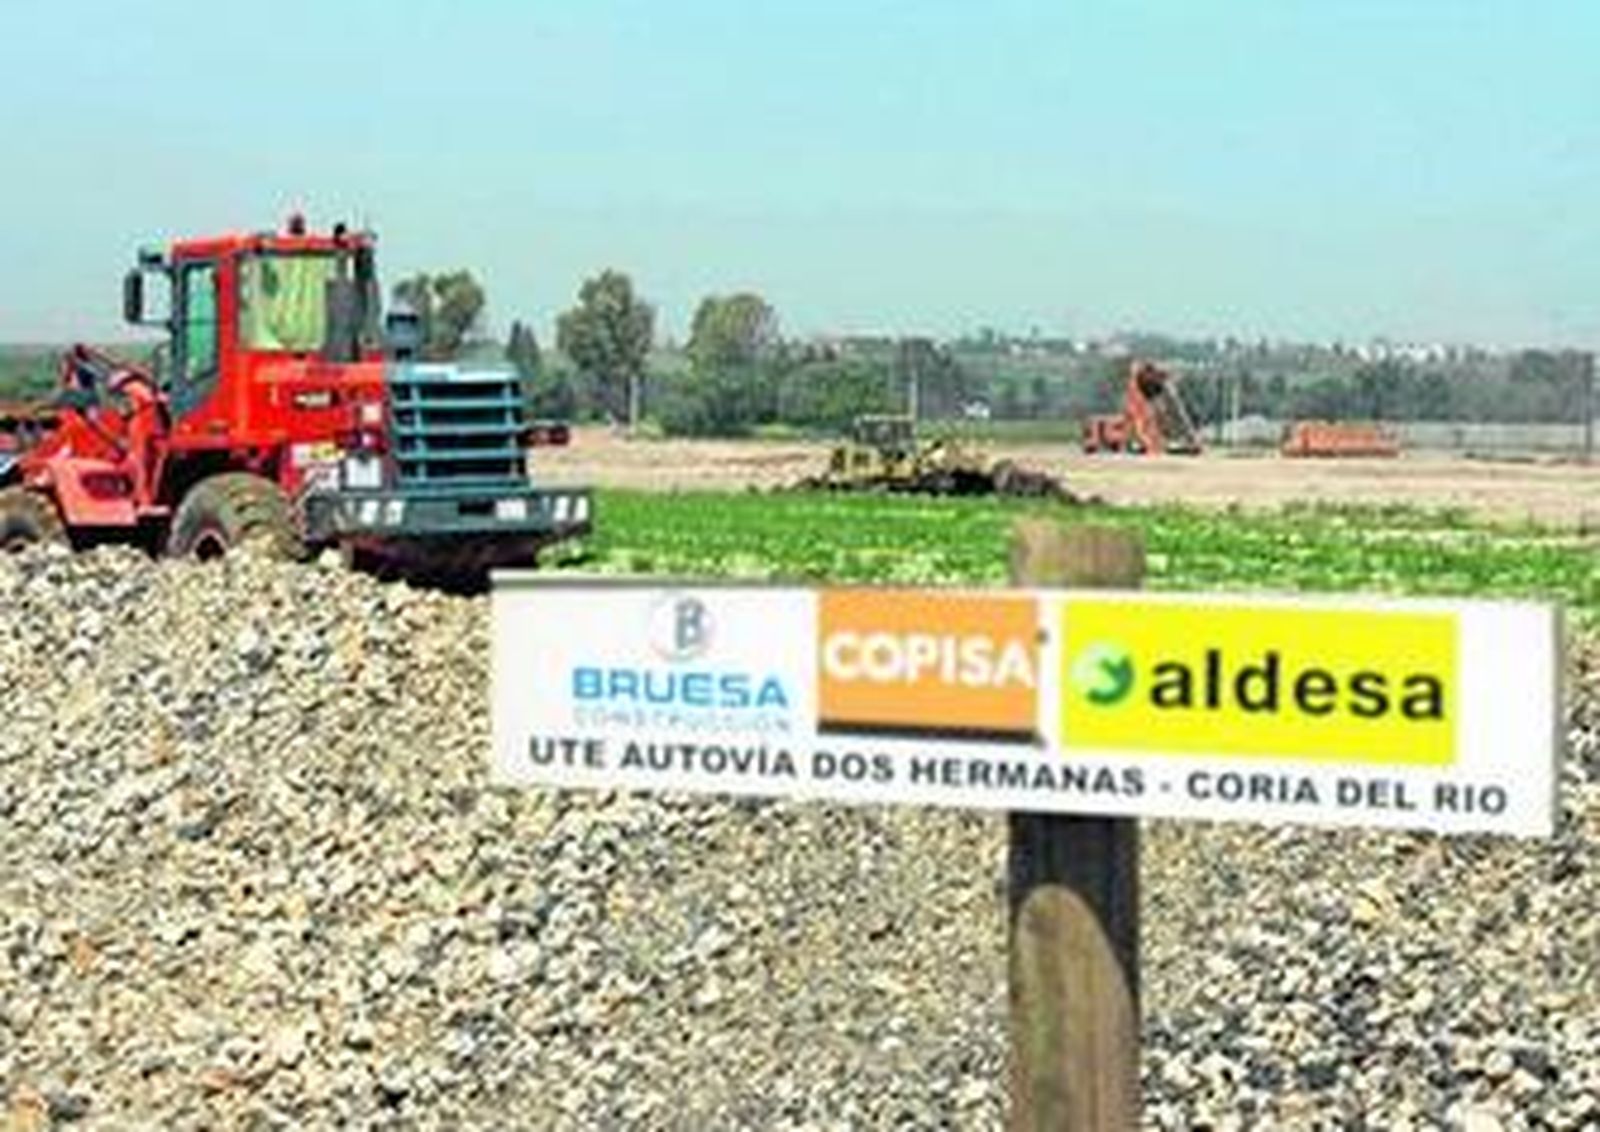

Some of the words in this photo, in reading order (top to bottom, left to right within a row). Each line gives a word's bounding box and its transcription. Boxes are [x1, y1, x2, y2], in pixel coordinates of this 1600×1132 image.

[572, 667, 788, 708] BRUESA
[823, 630, 1035, 688] COPISA
[1149, 648, 1445, 721] aldesa
[529, 737, 604, 768] UTE
[812, 752, 895, 782] DOS
[909, 758, 1146, 797] HERMANAS
[1186, 771, 1320, 804] CORIA
[1336, 779, 1416, 811] DEL
[1434, 783, 1507, 815] RIO
